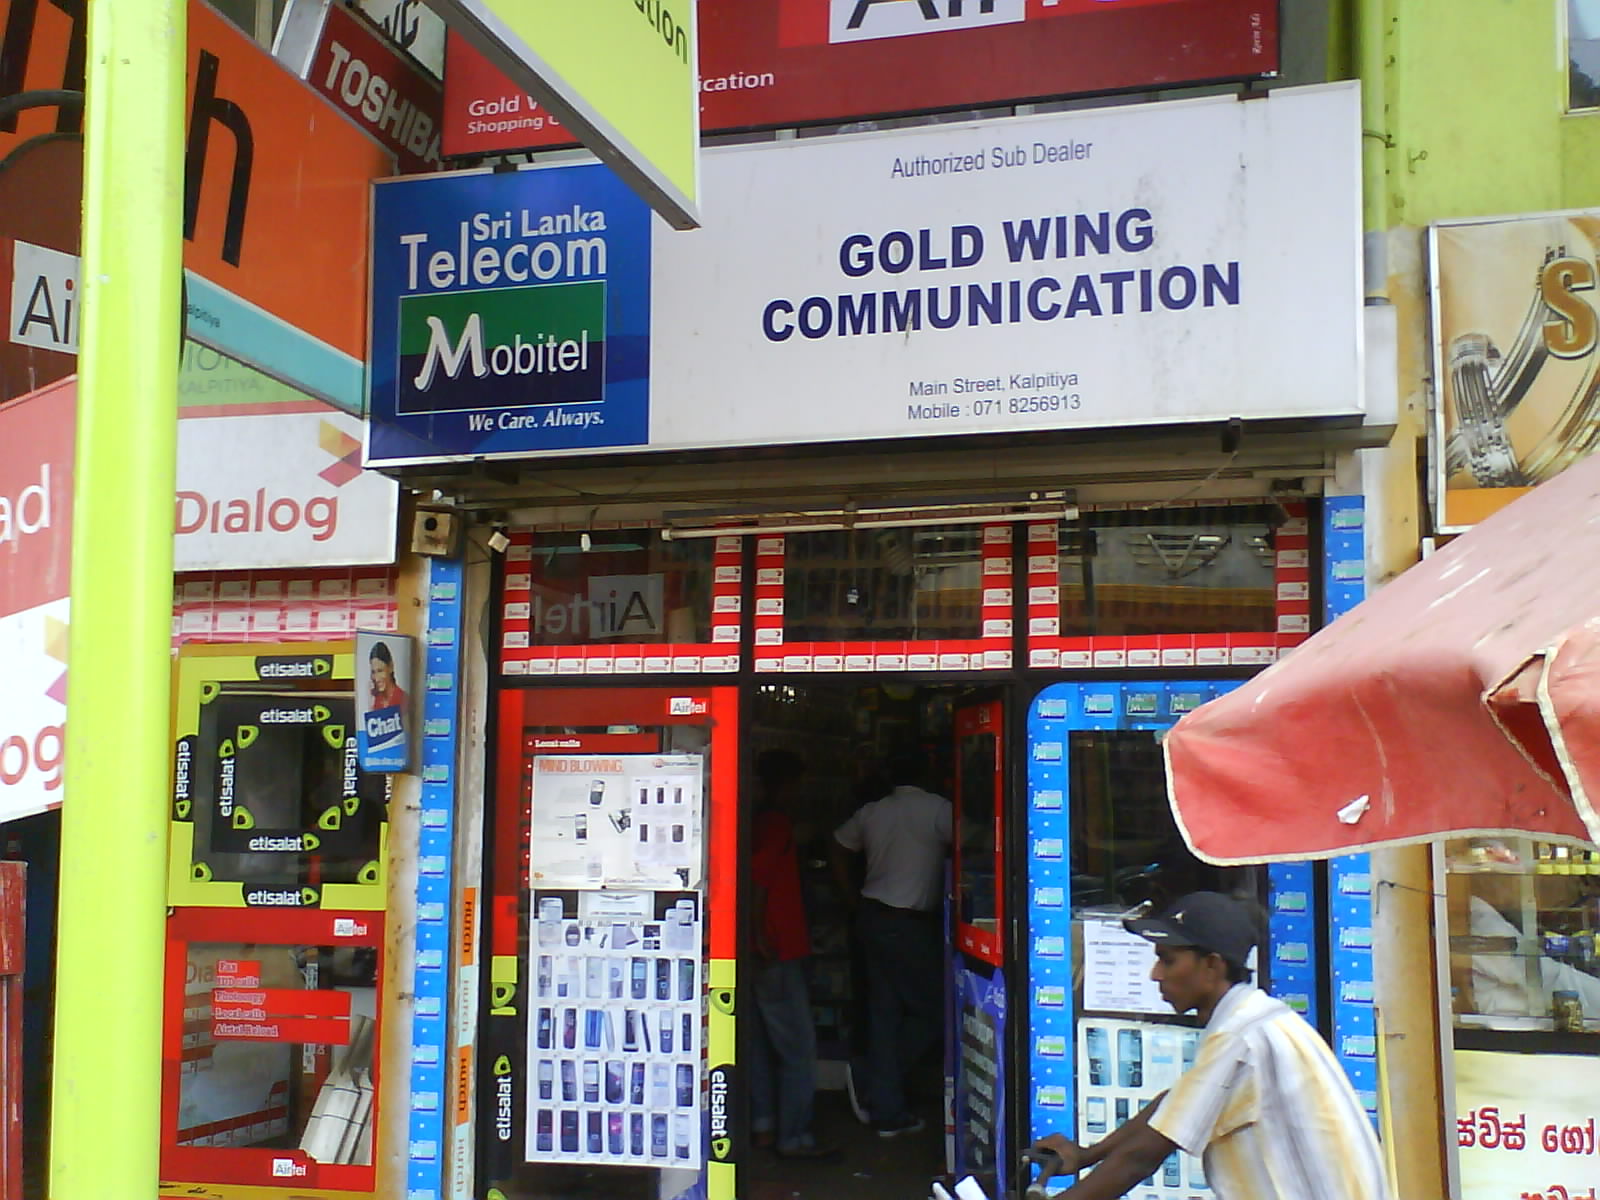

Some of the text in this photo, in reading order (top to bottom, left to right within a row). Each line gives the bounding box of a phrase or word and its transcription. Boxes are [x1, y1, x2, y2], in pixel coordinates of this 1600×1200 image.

[468, 95, 520, 117] Gold
[467, 117, 544, 135] Shopping
[891, 140, 1093, 179] Authorized Sub Dealer
[472, 204, 608, 241] Sri Lanka
[400, 221, 608, 290] Telecom
[839, 208, 1154, 277] GOLD WING
[762, 262, 1241, 342] COMMUNICATION
[414, 313, 589, 391] Mobitel
[908, 371, 1079, 397] Main Street, Kalpitiya
[468, 408, 605, 432] We Care. Always.
[907, 402, 961, 420] Mobile
[1008, 394, 1081, 414] 8256913
[175, 487, 338, 541] Dialog
[259, 661, 313, 678] etisalat
[259, 708, 314, 724] etisalat
[367, 713, 402, 738] Chat
[175, 740, 190, 800] etisalat
[343, 736, 359, 797] etisalat
[220, 757, 235, 817] etisalat
[248, 836, 304, 851] etisalat
[247, 890, 303, 906] etisalat
[496, 1075, 513, 1140] etisalat
[711, 1071, 730, 1138] etisalat
